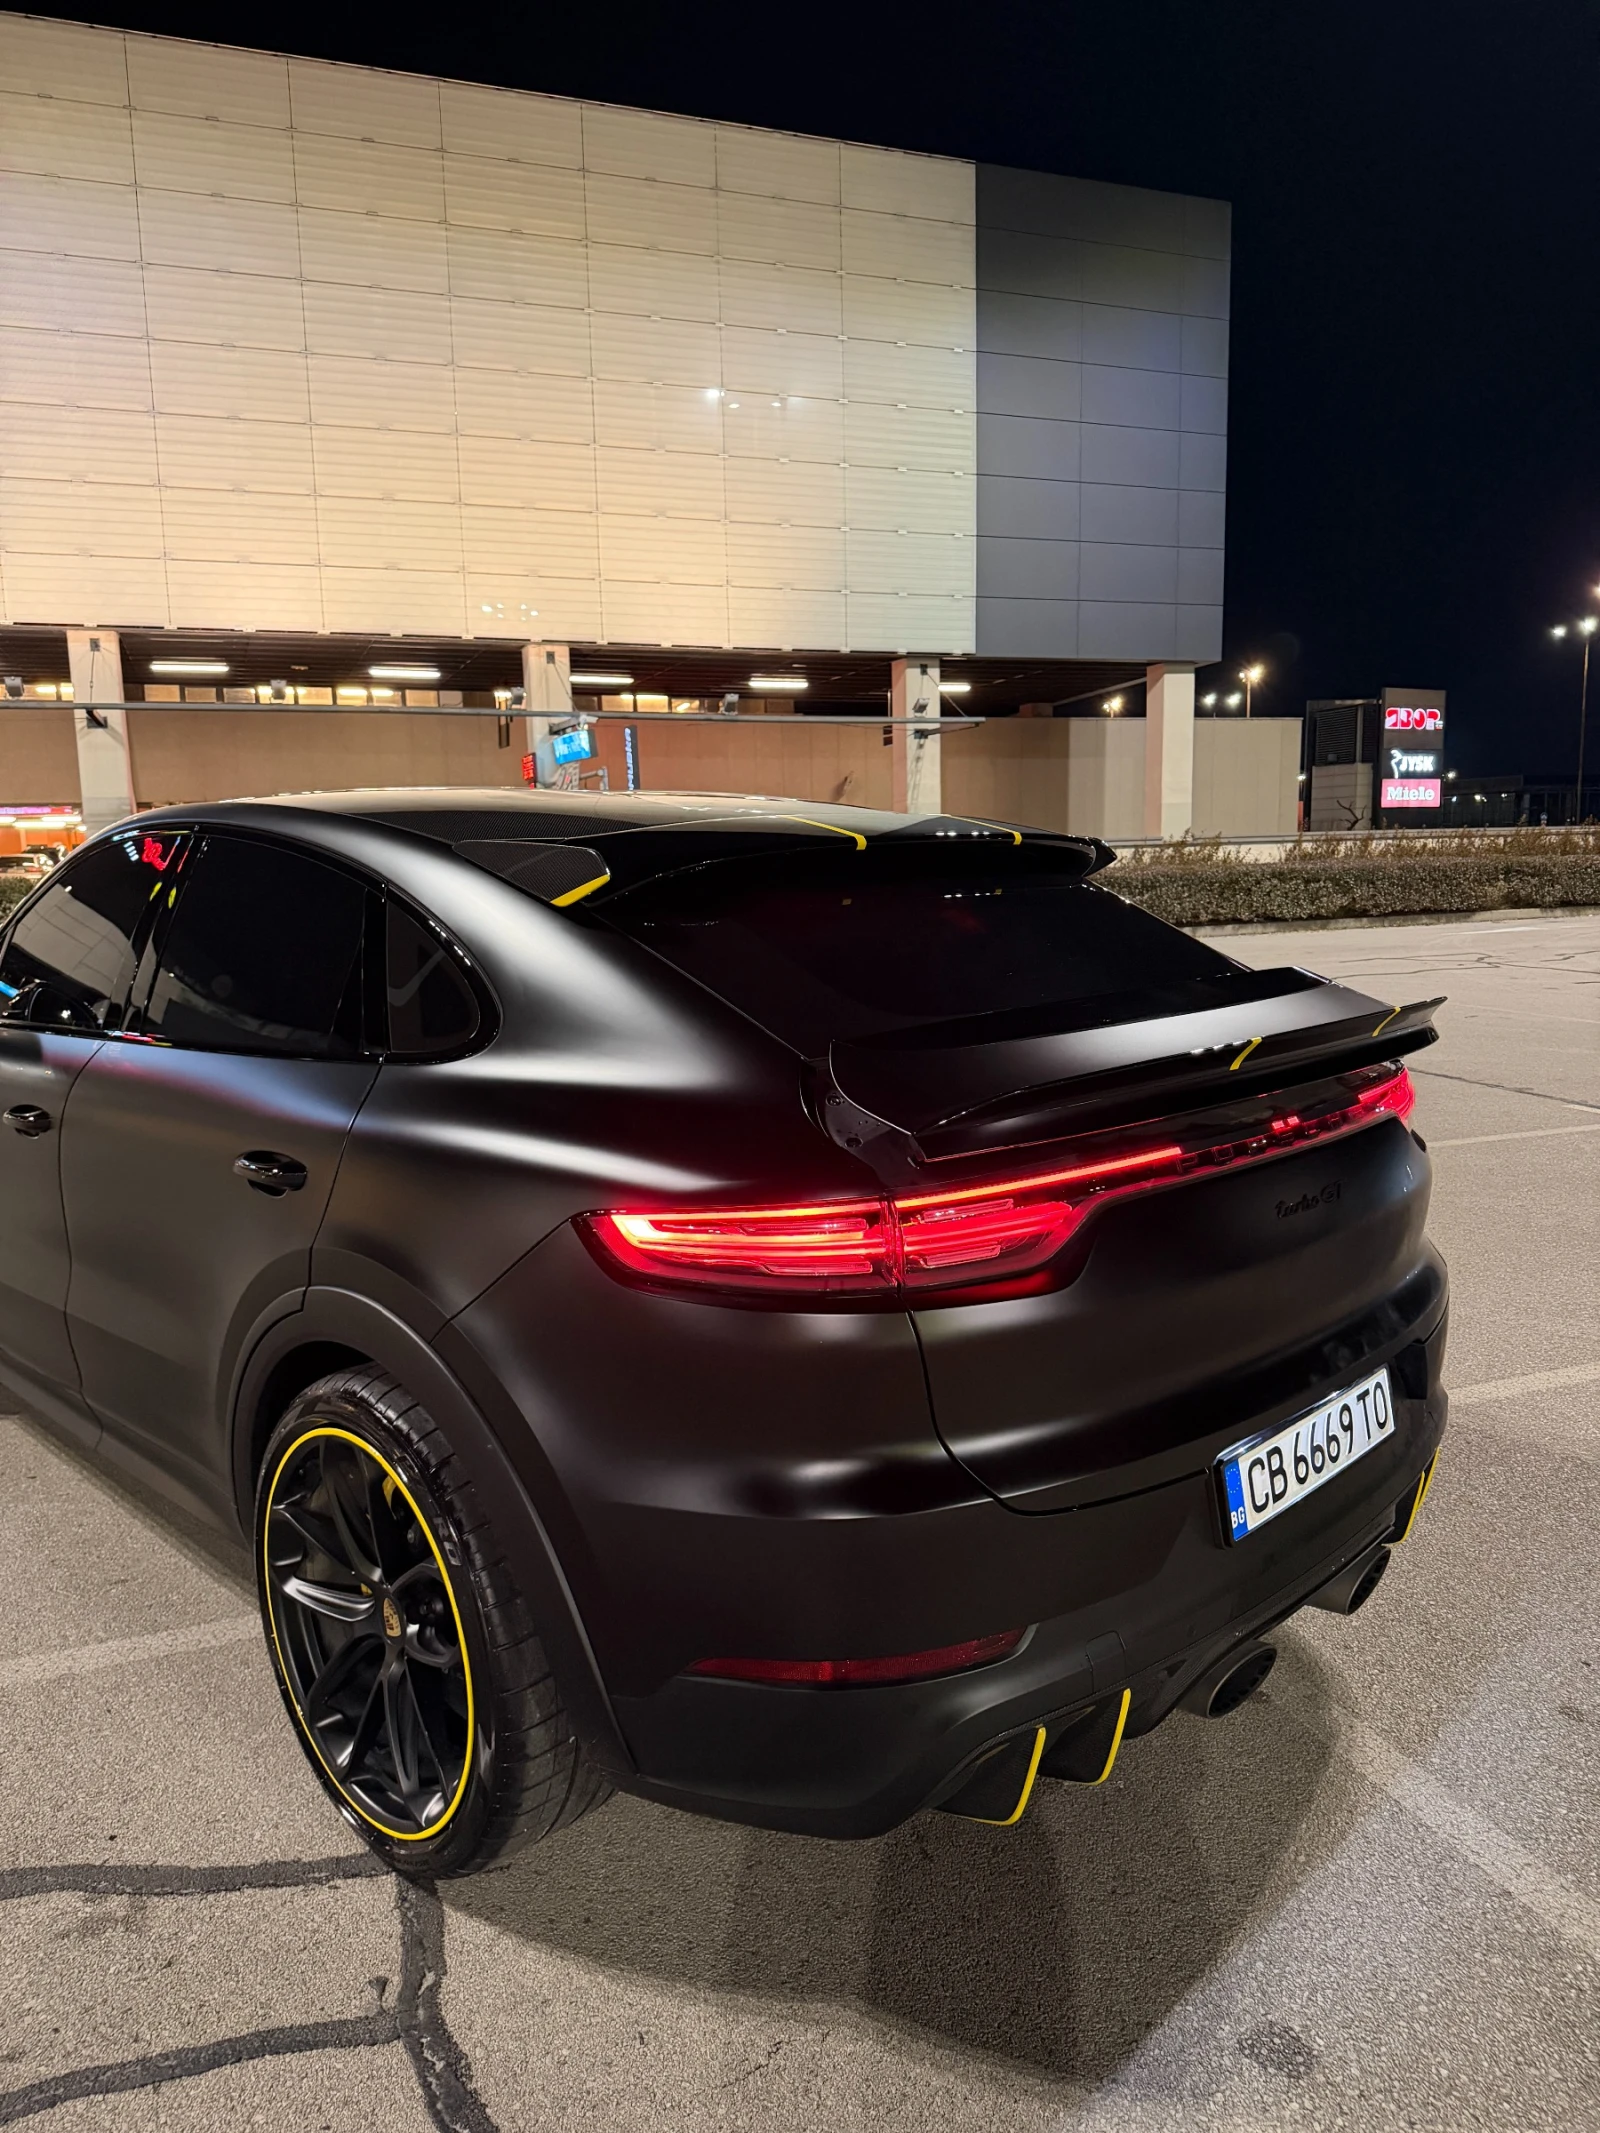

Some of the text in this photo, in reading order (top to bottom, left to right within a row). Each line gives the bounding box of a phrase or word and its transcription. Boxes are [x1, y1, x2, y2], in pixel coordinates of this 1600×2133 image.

[1385, 707, 1440, 730] ЯВОР
[1399, 756, 1434, 771] JYSK
[1386, 786, 1435, 801] Miele
[1247, 1381, 1389, 1514] CB 6669 TO
[1230, 1507, 1246, 1529] BG
